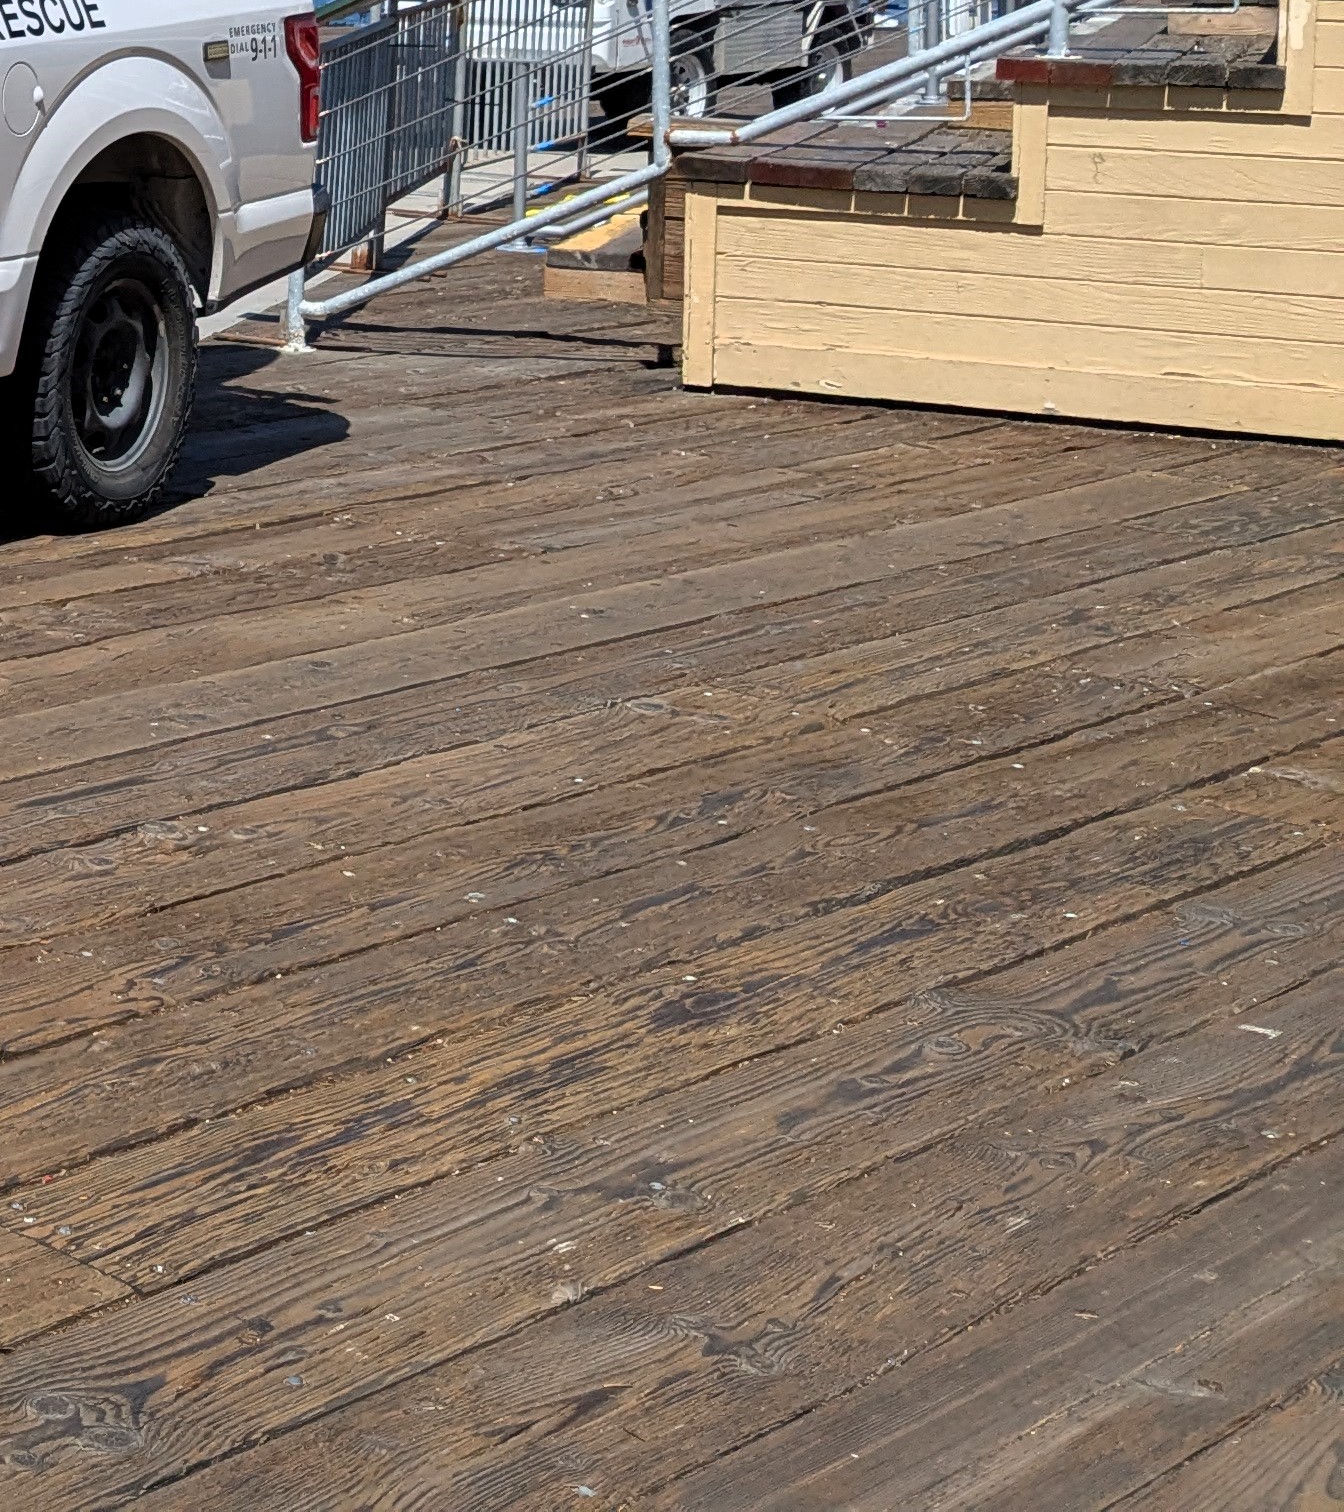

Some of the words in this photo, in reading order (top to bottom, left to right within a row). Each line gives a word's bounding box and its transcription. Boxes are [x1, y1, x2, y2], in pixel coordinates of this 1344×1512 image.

[229, 22, 276, 38] EMERGENCY
[230, 42, 249, 55] DIAL
[250, 35, 277, 61] 9-1-1
